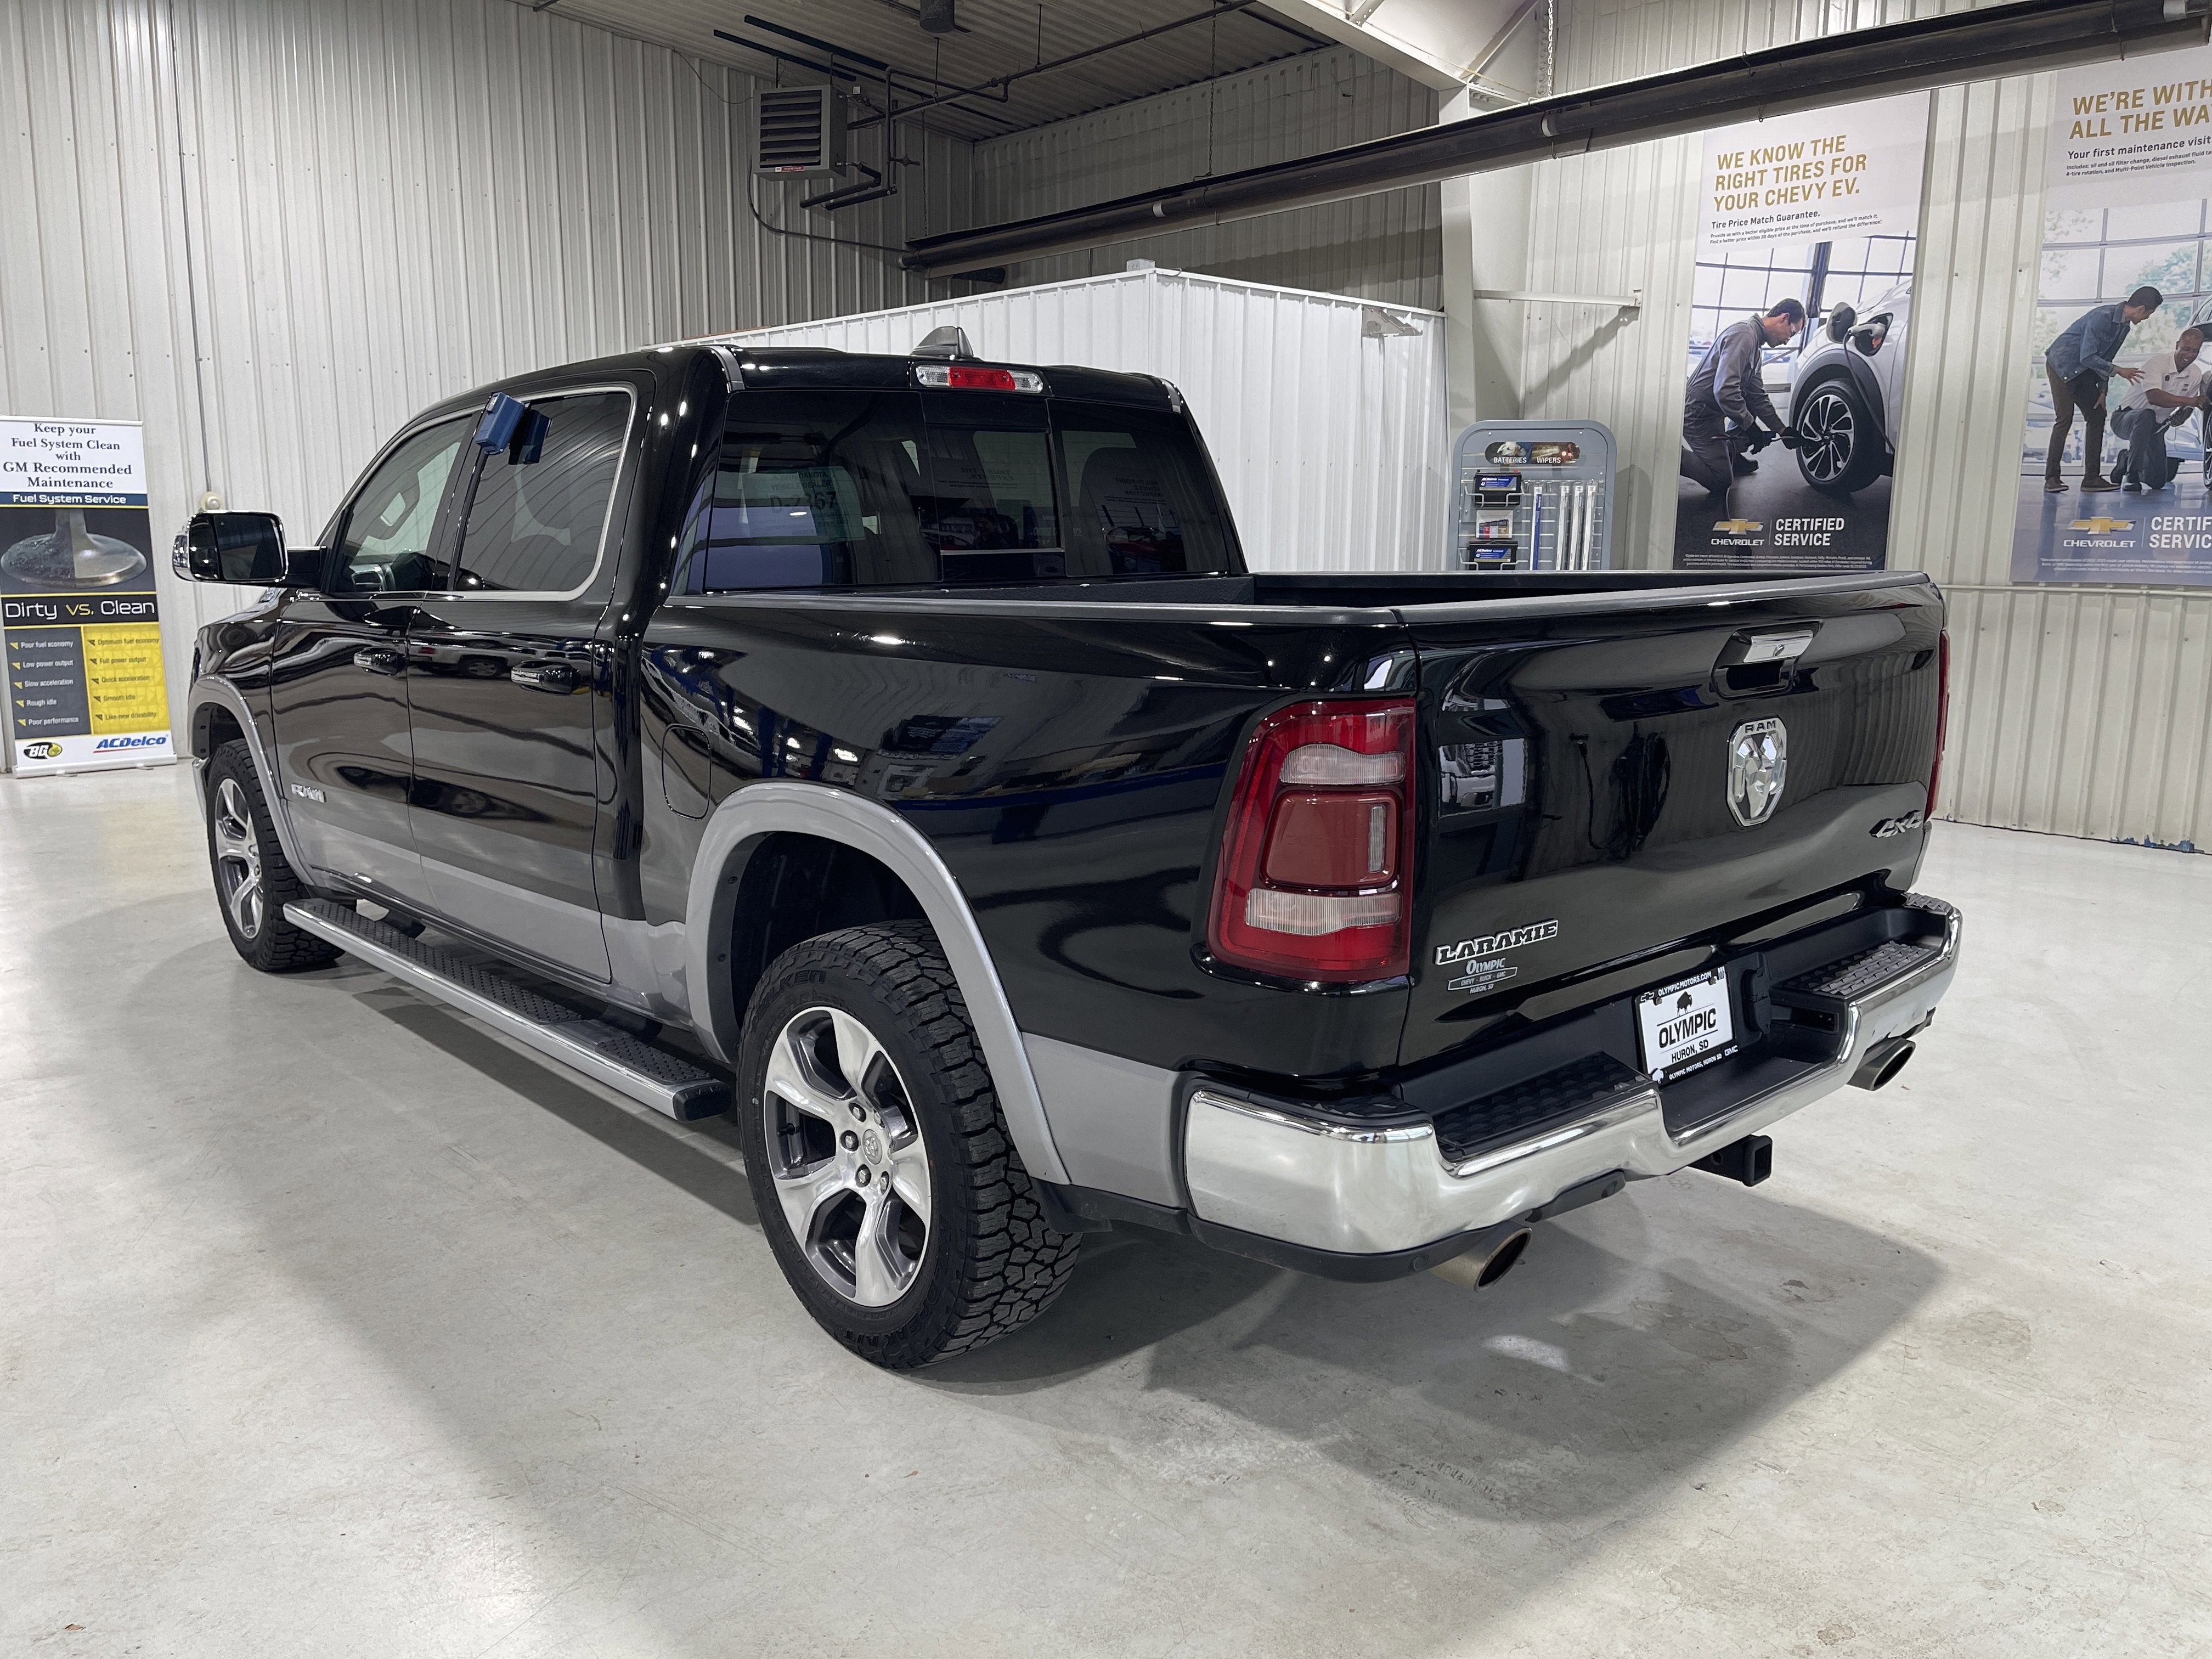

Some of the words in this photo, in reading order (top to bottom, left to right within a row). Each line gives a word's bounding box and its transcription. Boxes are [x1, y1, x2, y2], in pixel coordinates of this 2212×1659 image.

[2073, 88, 2145, 116] WE'RE
[2153, 79, 2212, 105] WITH
[2069, 118, 2112, 140] ALL
[2120, 110, 2165, 134] THE
[2172, 104, 2212, 128] WA
[1717, 151, 1745, 170] WE
[1750, 141, 1805, 165] KNOW
[1810, 134, 1847, 157] THE
[2068, 151, 2091, 159] Your
[2093, 148, 2115, 157] first
[2117, 140, 2185, 155] maintenance
[2187, 135, 2211, 146] visit
[1715, 169, 1768, 192] RIGHT
[1773, 161, 1824, 184] TIRES
[1830, 154, 1867, 176] FOR
[2115, 165, 2145, 173] Multi-Point
[1714, 192, 1758, 212] YOUR
[1764, 181, 1827, 206] CHEVY
[1832, 177, 1860, 198] EV.
[1712, 221, 1726, 229] Tire
[1728, 219, 1748, 228] Price
[1750, 215, 1774, 225] Match
[1776, 211, 1820, 222] Guarantee.
[34, 423, 65, 436] Keep
[69, 426, 96, 437] your
[11, 437, 37, 448] Fuel
[41, 438, 83, 451] System
[87, 439, 120, 450] Clean
[55, 452, 81, 461] with
[3, 461, 27, 472] GM
[33, 462, 132, 475] Recommended
[27, 476, 114, 488] Maintenance
[771, 482, 802, 490] VEHICLE
[803, 481, 832, 489] DEALER
[13, 494, 37, 503] Fuel
[39, 494, 82, 505] System
[84, 495, 126, 504] Service
[1775, 517, 1845, 532] CERTIFIED
[1774, 533, 1831, 546] SERVICE
[2063, 539, 2136, 548] CHEVROLET
[5, 602, 58, 620] Dirty
[65, 603, 94, 617] vs.
[100, 600, 155, 615] Clean
[43, 717, 79, 726] performance
[1745, 720, 1778, 733] RAM
[95, 736, 167, 749] ACDelco
[1435, 919, 1559, 966] LARAMIE
[1460, 977, 1474, 986] CHEVY
[1479, 974, 1492, 983] BUICK
[1496, 971, 1506, 979] GMC
[1658, 971, 1712, 996] OLYMPICMOTORS.COM
[1658, 1008, 1717, 1048] OLYMPIC
[1671, 1044, 1698, 1063] HURON,
[1699, 1039, 1709, 1051] SD
[1724, 1045, 1739, 1057] GMC
[1669, 1069, 1686, 1080] OLYMPIC
[1703, 1057, 1716, 1066] HURON
